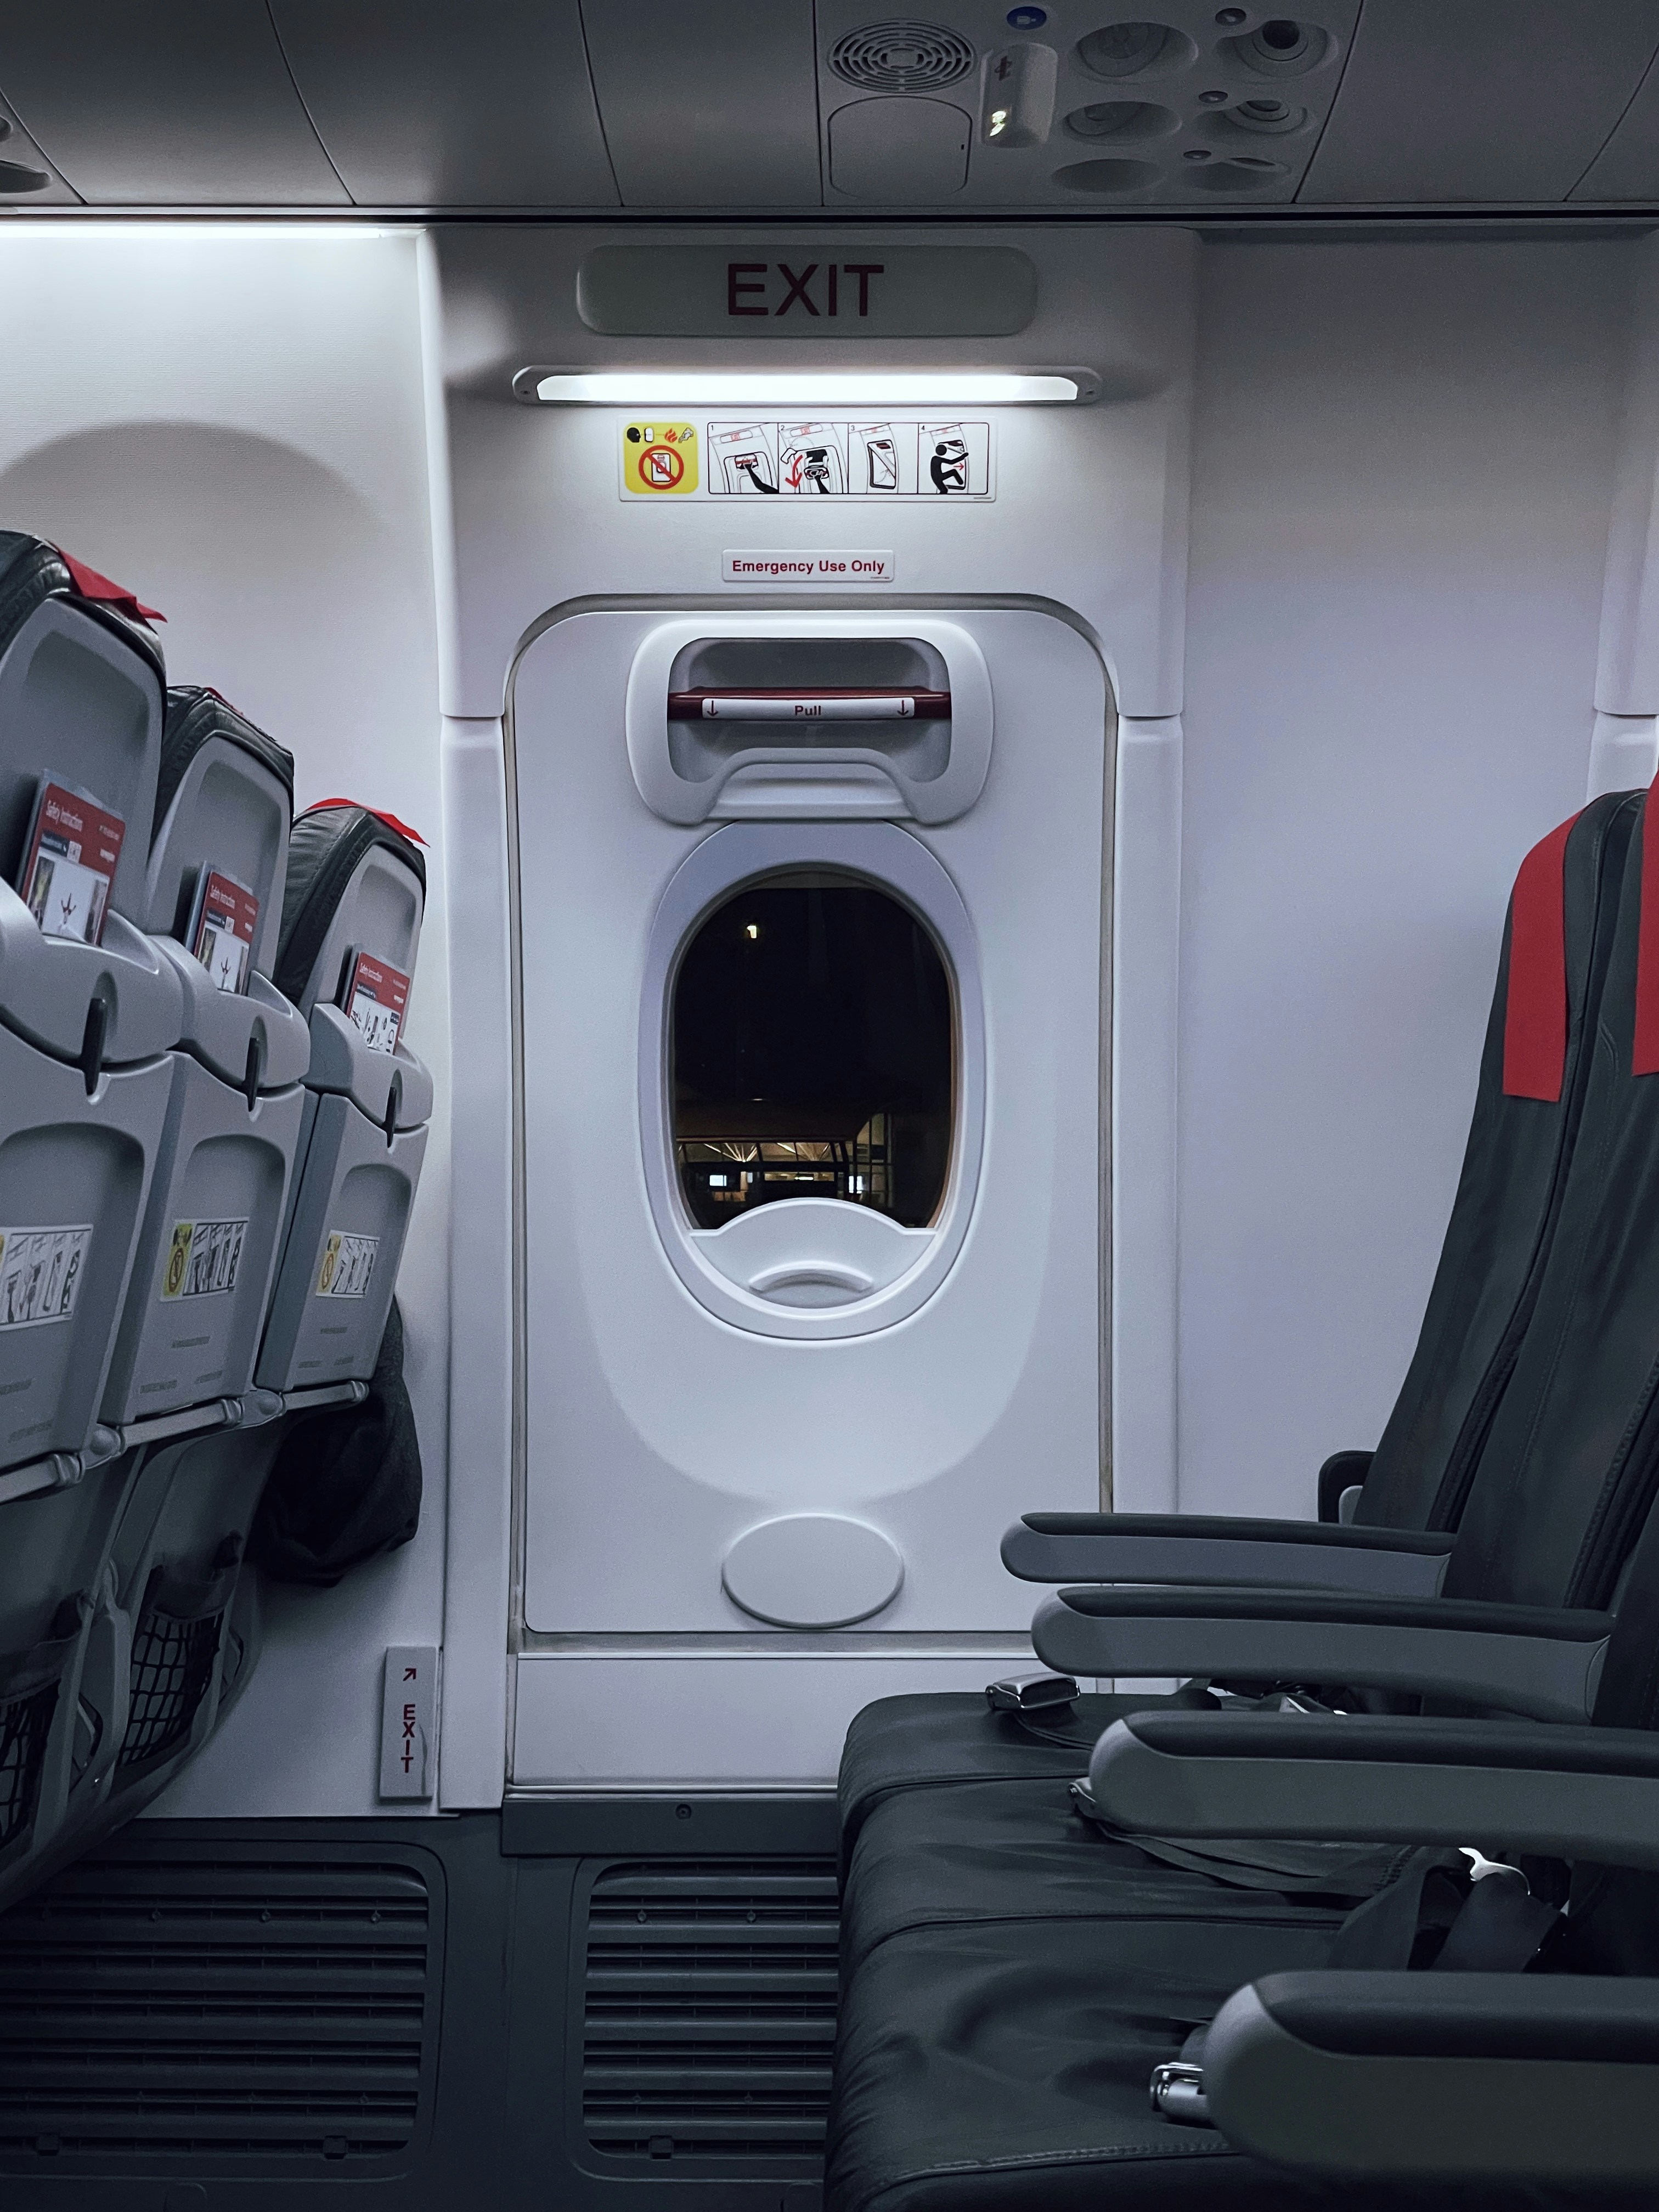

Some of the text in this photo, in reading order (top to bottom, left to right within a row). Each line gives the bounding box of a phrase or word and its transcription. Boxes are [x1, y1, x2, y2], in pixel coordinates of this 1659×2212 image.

[728, 263, 884, 317] EXIT
[732, 560, 884, 574] Emergency Use Only
[795, 706, 821, 715] Pull
[401, 1704, 415, 1773] EXIT
